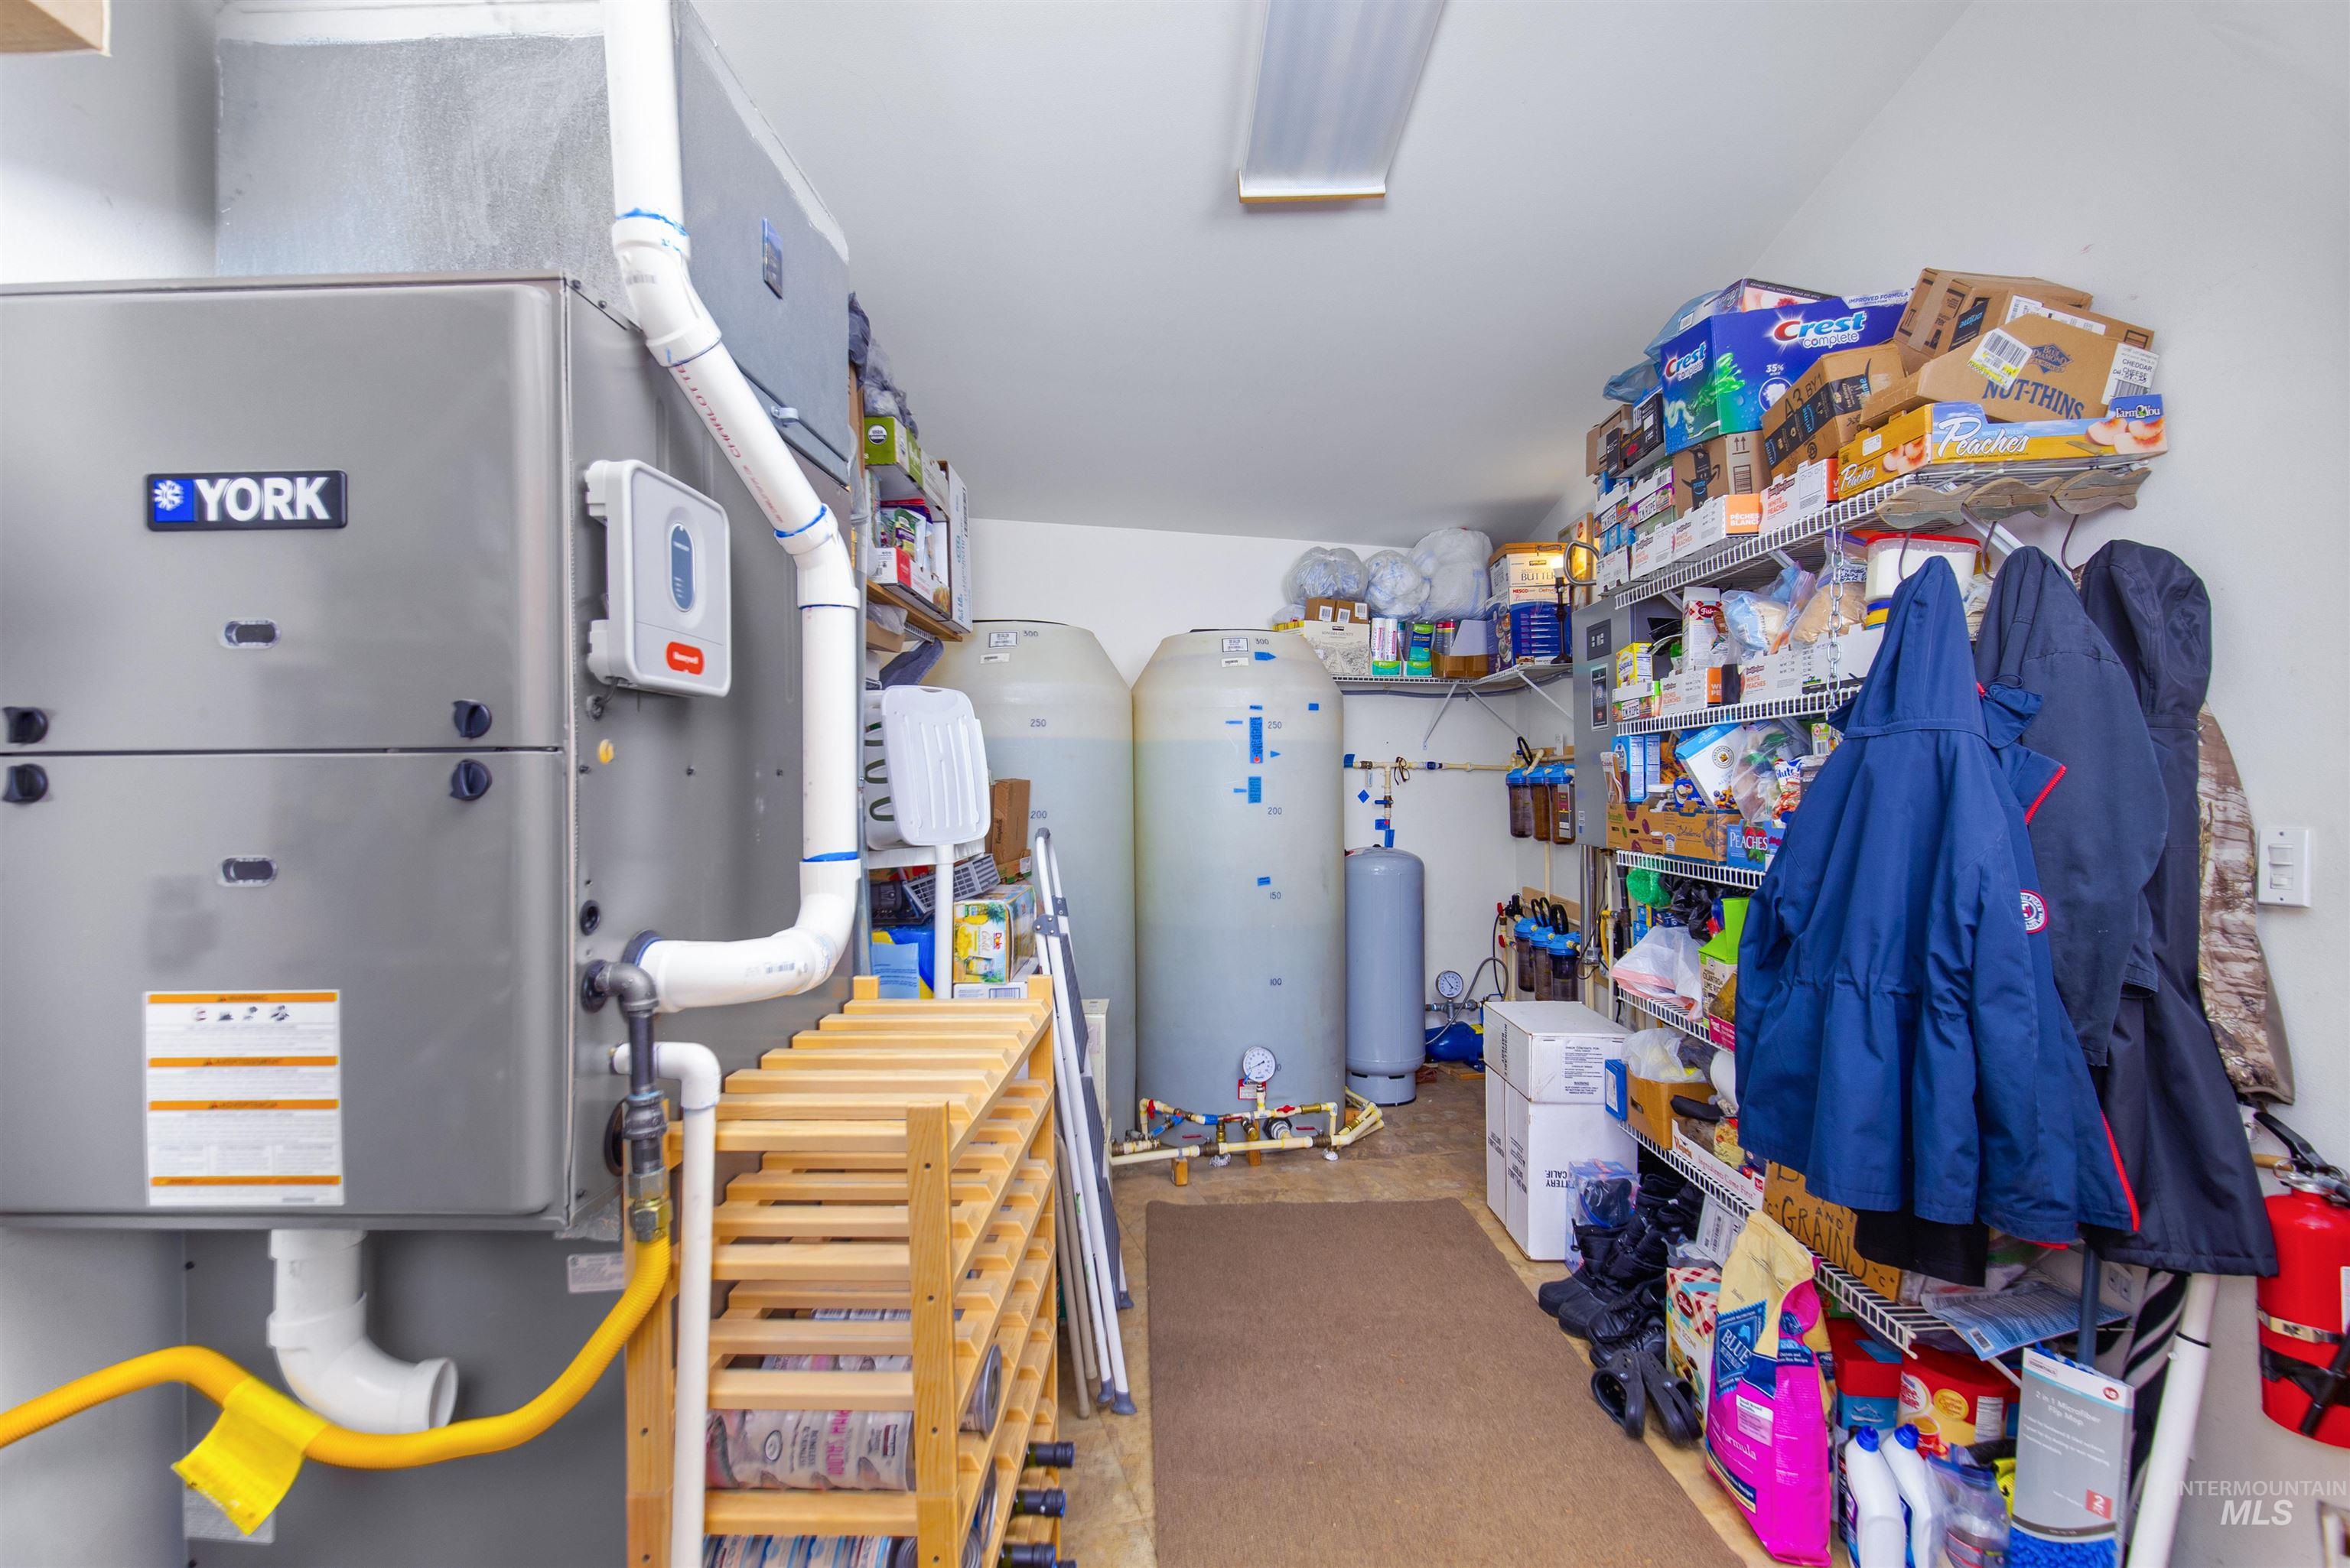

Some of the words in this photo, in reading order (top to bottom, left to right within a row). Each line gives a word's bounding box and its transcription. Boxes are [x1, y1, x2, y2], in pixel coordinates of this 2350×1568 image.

[1847, 294, 1880, 304] IMPROVED
[1880, 291, 1909, 300] FORMULA
[1773, 311, 1867, 342] Crest
[1803, 332, 1859, 349] complete
[1665, 341, 1707, 379] Crest
[2033, 349, 2067, 365] DIAMOND
[2122, 358, 2153, 372] CHEDDAR
[1677, 362, 1703, 381] complete
[1766, 364, 1784, 373] 35%
[2123, 367, 2149, 379] CHEESE
[1981, 378, 2085, 420] NUT-THINS
[1938, 417, 2031, 457] Peaches
[1840, 463, 1876, 492] Peaches
[194, 477, 333, 522] YORK
[1746, 680, 1766, 689] PEACHES
[1030, 718, 1046, 727] 250
[1268, 721, 1282, 730] 250
[1030, 810, 1047, 819] 200
[1268, 807, 1282, 815] 200
[1730, 831, 1768, 851] PEACHES
[1702, 971, 1723, 987] CILANTRO
[1544, 1169, 1567, 1179] CALIF.
[1720, 1328, 1753, 1365] BLUE
[2048, 1405, 2063, 1418] Flip
[2064, 1410, 2084, 1426] Mop
[2058, 1400, 2101, 1425] Microfiber
[2093, 1494, 2104, 1509] 2
